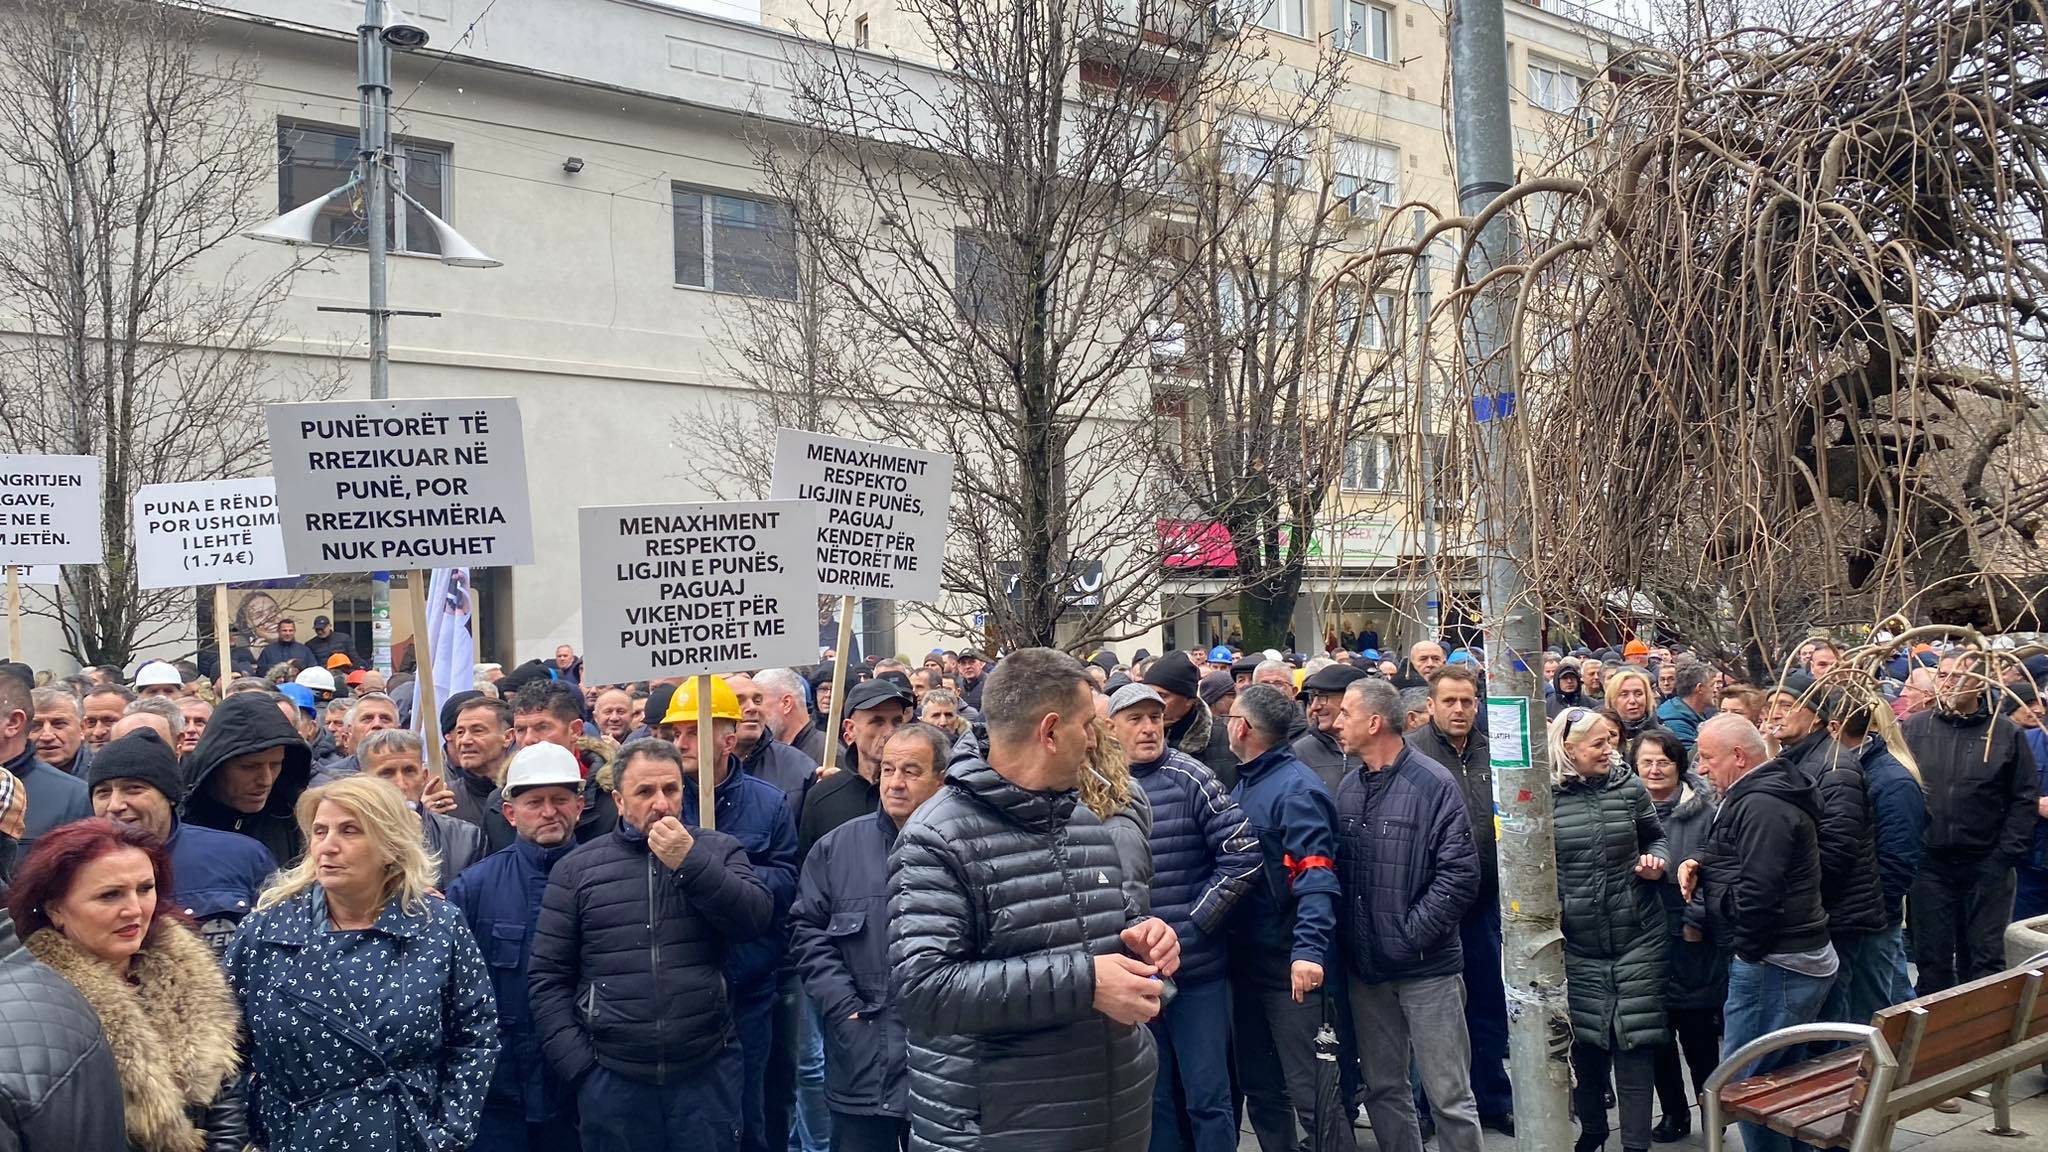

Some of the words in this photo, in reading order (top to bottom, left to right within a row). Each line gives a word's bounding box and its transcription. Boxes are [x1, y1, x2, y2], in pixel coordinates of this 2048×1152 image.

[300, 414, 450, 440] PUNËTORËT
[458, 411, 489, 435] TË
[308, 448, 450, 471] RREZIKUAR
[454, 442, 489, 466] NË
[807, 443, 928, 476] MENAXHMENT
[336, 478, 411, 500] PUNË,
[416, 478, 469, 497] POR
[823, 467, 907, 493] RESPEKTO
[0, 493, 55, 508] GAVE,
[144, 501, 201, 516] PUNA
[204, 499, 215, 512] E
[798, 484, 853, 503] LIGJIN
[855, 491, 867, 507] E
[869, 493, 925, 517] PUNËS,
[11, 513, 36, 526] NE
[40, 513, 51, 526] E
[149, 519, 191, 534] POR
[305, 503, 507, 532] RREZIKSHMËRIA
[619, 511, 780, 536] MENAXHMENT
[828, 508, 894, 530] PAGUAJ
[10, 530, 71, 546] JETËN.
[183, 538, 188, 550] I
[193, 530, 252, 549] LEHTË
[321, 541, 378, 561] NUK
[382, 536, 496, 559] PAGUHET
[645, 534, 756, 557] RESPEKTO
[816, 527, 884, 548] KENDET
[885, 531, 916, 552] PËR
[183, 550, 254, 571] (1.74€)
[617, 560, 687, 581] LIGJIN
[691, 558, 704, 577] E
[709, 552, 785, 576] PUNËS,
[816, 544, 892, 569] NËTORËT
[893, 554, 918, 571] ME
[660, 578, 745, 601] PAGUAJ
[817, 568, 894, 589] NDRRIME.
[625, 601, 736, 625] VIKENDET
[739, 594, 778, 617] PËR
[620, 621, 749, 648] PUNËTORËT
[753, 618, 785, 637] ME
[651, 643, 758, 668] NDRRIME.
